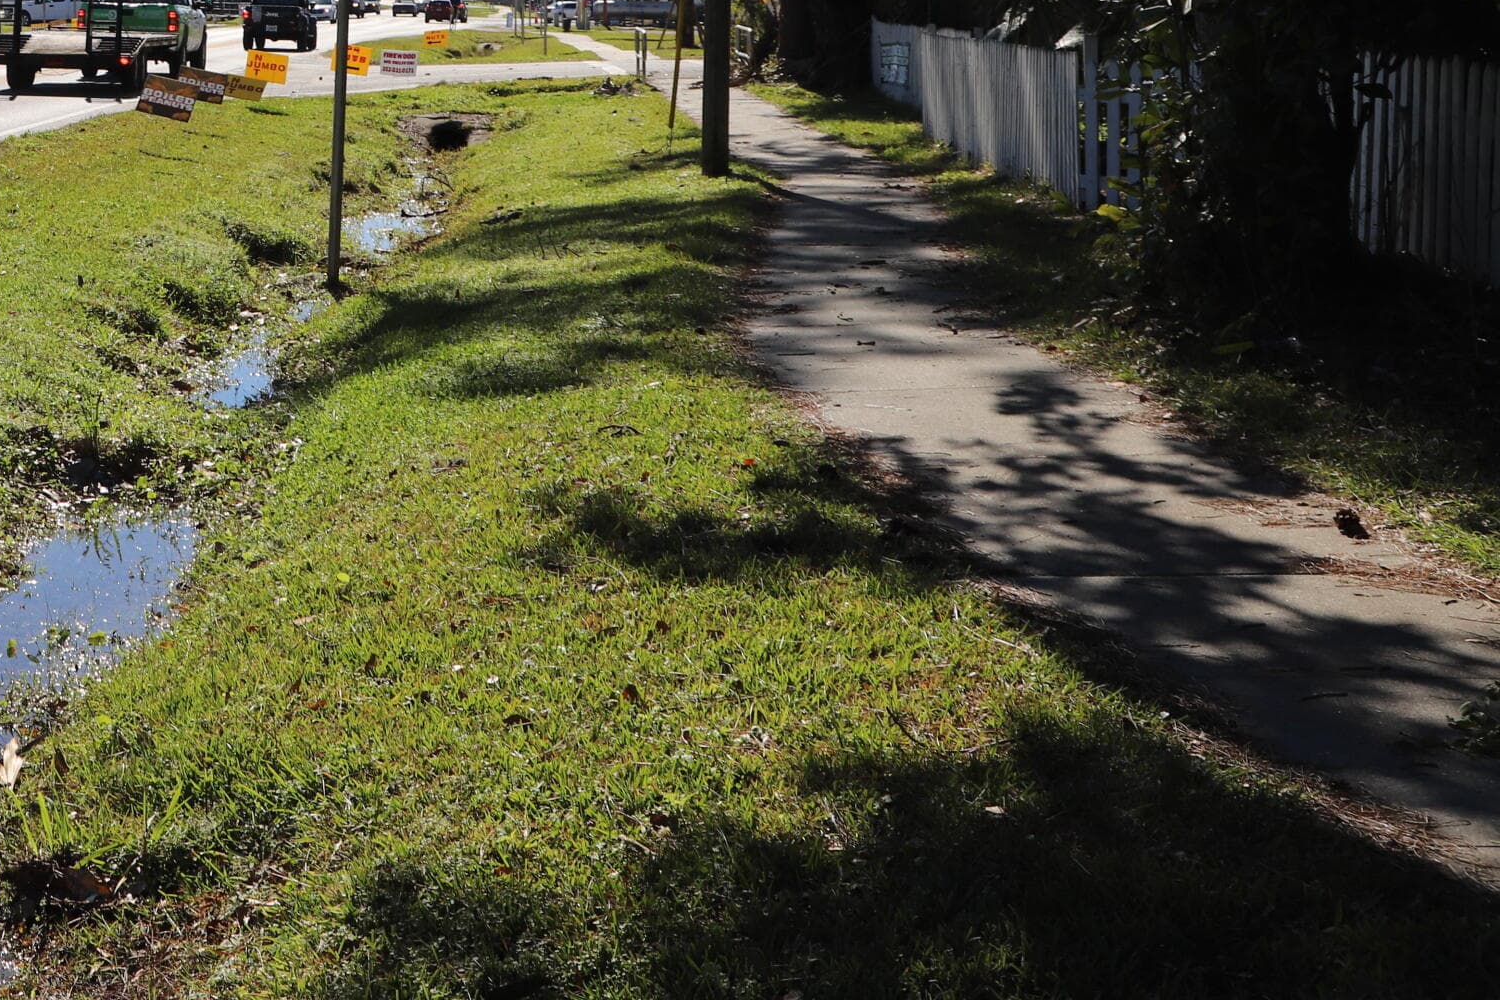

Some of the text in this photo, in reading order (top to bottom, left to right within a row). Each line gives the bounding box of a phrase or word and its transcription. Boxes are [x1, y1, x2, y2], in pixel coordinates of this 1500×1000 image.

[383, 52, 417, 60] FIREWOOD
[247, 60, 286, 72] JUMBO
[179, 76, 225, 90] BOILED
[141, 94, 193, 112] PEANUTS
[143, 88, 195, 106] BOILED
